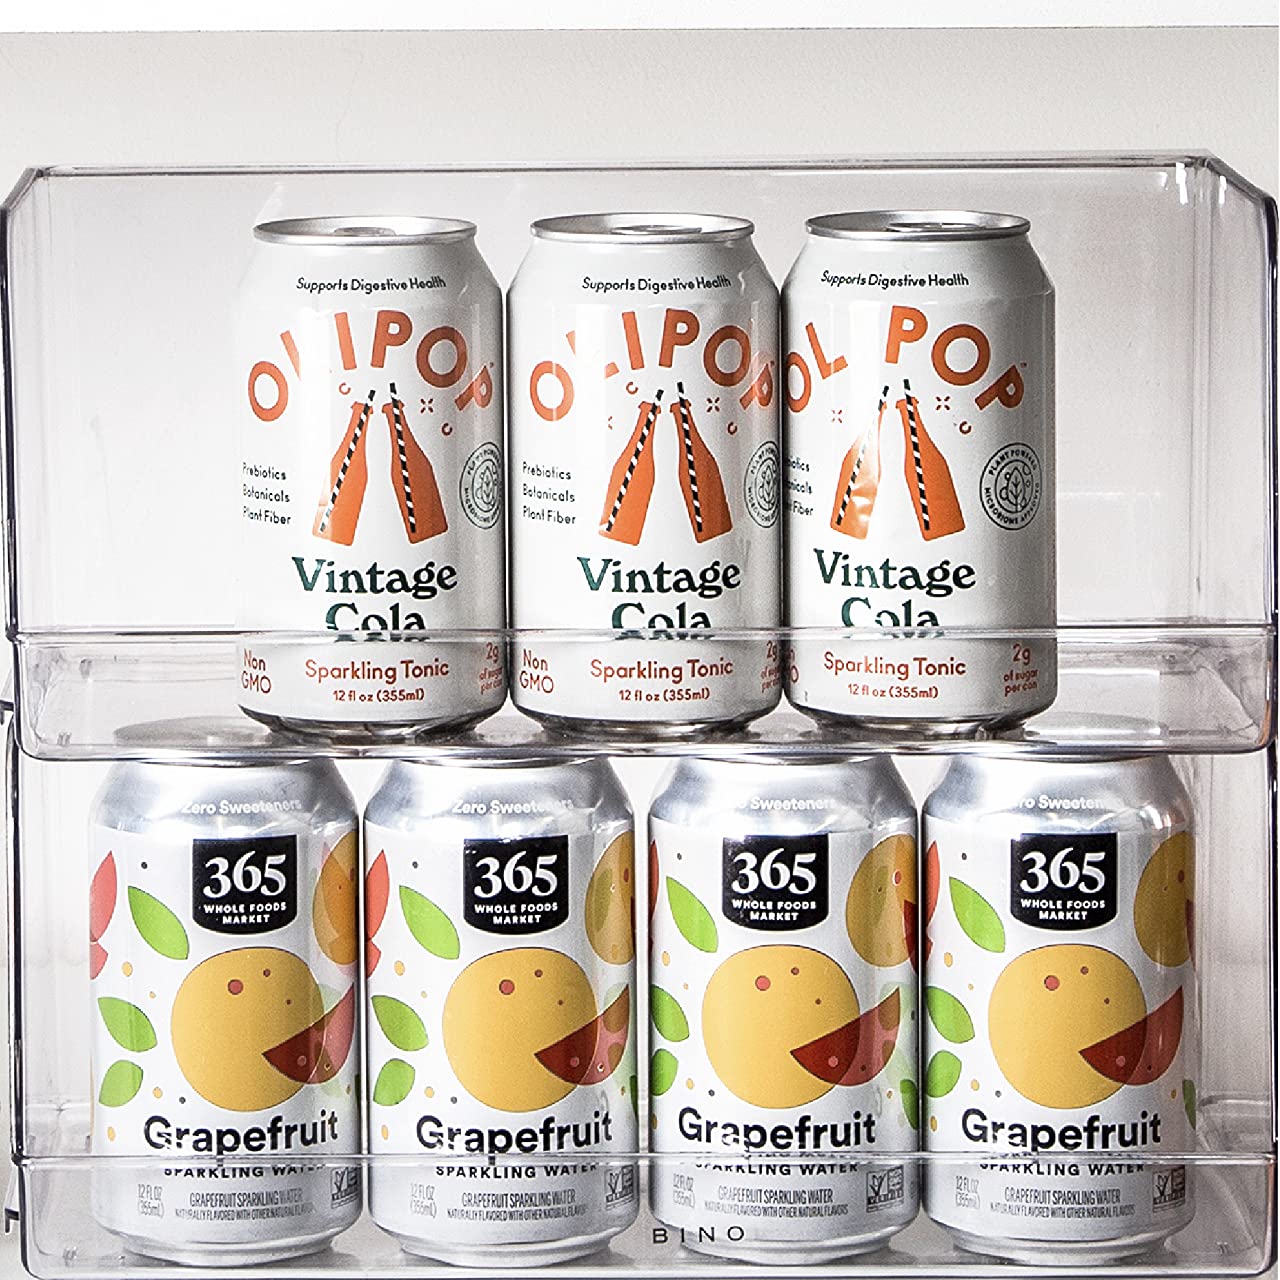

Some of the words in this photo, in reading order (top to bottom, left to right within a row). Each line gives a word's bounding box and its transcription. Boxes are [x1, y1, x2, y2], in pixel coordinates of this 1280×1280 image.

[296, 277, 349, 294] Supports
[350, 278, 409, 295] Digestive
[409, 276, 447, 290] Health
[582, 276, 636, 294] Supports
[638, 277, 695, 295] Digestive
[696, 275, 732, 289] Health
[820, 269, 867, 288] Supports
[868, 273, 926, 290] Digestive
[928, 272, 969, 287] Health
[785, 305, 1025, 413] OLPOP
[242, 461, 287, 481] Prebiotics
[522, 461, 572, 480] Prebiotics
[242, 484, 291, 503] Botanicals
[522, 483, 576, 503] Botanicals
[242, 506, 263, 522] Plant
[264, 506, 292, 525] Fiber
[522, 505, 545, 521] Plant
[547, 506, 576, 524] Fiber
[291, 556, 458, 600] Vintage
[576, 556, 741, 599] Vintage
[813, 548, 976, 598] Vintage
[325, 601, 430, 637] Cola
[610, 601, 714, 636] Cola
[841, 597, 944, 633] Cola
[243, 647, 267, 671] Non
[485, 641, 500, 663] 2g
[523, 648, 548, 671] Non
[1012, 643, 1031, 666] 2g
[304, 658, 397, 685] Sparkling
[400, 657, 449, 679] Tonic
[590, 658, 683, 684] Sparkling
[686, 657, 734, 678] Tonic
[823, 651, 909, 681] Sparkling
[913, 656, 967, 677] Tonic
[1003, 671, 1013, 682] of
[1014, 668, 1038, 682] sugar
[240, 672, 272, 694] GMO
[519, 671, 554, 694] GMO
[889, 685, 939, 699] (355ml)
[333, 690, 346, 702] 12
[347, 690, 357, 702] fl
[359, 693, 374, 702] oz
[376, 688, 425, 703] (355ml)
[663, 687, 710, 702] (355ml)
[180, 800, 217, 814] Zero
[219, 799, 302, 814] Sweeteners
[203, 850, 287, 899] 365
[473, 850, 558, 899] 365
[731, 847, 817, 895] 365
[1020, 847, 1106, 894] 365
[203, 903, 245, 913] WHOLE
[249, 902, 287, 912] FOODS
[474, 903, 516, 914] WHOLE
[521, 902, 558, 913] FOODS
[731, 899, 773, 909] WHOLE
[777, 900, 817, 910] FOODS
[1020, 898, 1063, 909] WHOLE
[1066, 900, 1106, 909] FOODS
[222, 914, 270, 925] MARKET
[492, 914, 542, 925] MARKET
[750, 911, 799, 921] MARKET
[1038, 910, 1088, 920] MARKET
[143, 1109, 338, 1157] Grapefruit
[416, 1110, 612, 1157] Grapefruit
[678, 1106, 876, 1151] Grapefruit
[961, 1107, 1161, 1152] Grapefruit
[436, 1165, 536, 1179] SPARKLING
[798, 1163, 858, 1176] WATER
[1088, 1163, 1145, 1176] WATER
[1004, 1186, 1051, 1203] GRAPEFRUIT
[1051, 1188, 1095, 1205] SPARKLING
[1095, 1188, 1121, 1204] WATER
[653, 1225, 745, 1244] BINO
